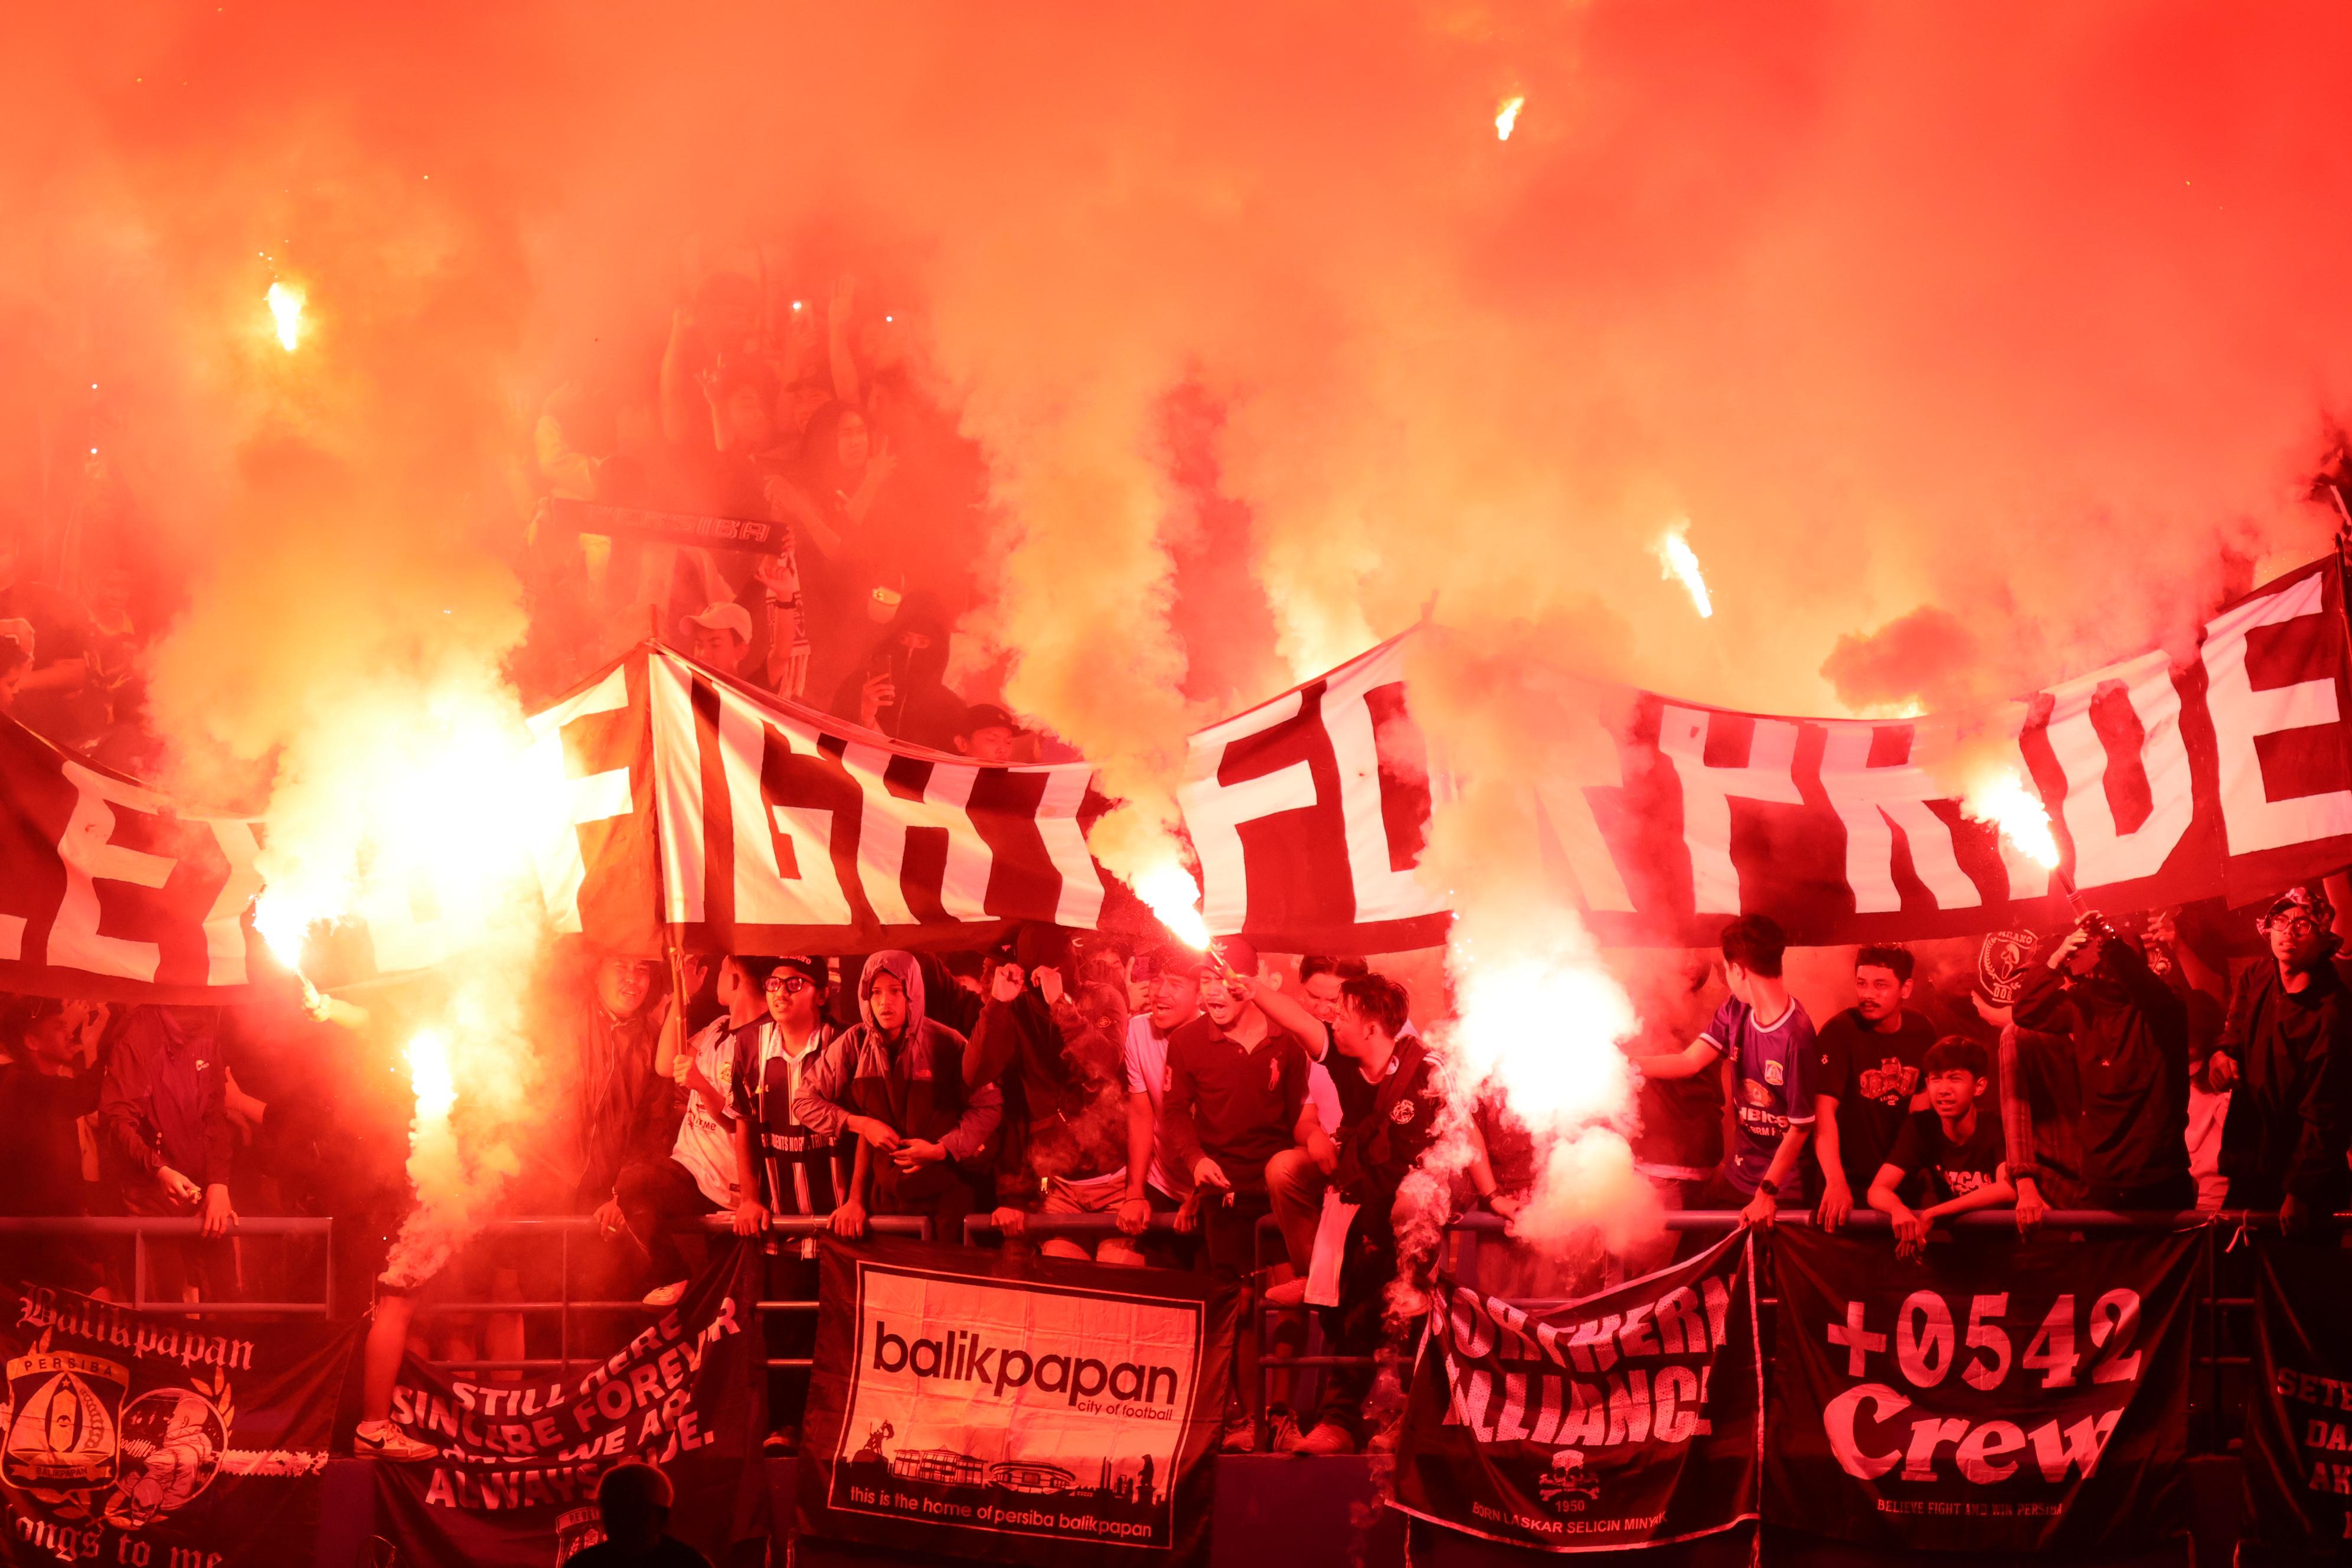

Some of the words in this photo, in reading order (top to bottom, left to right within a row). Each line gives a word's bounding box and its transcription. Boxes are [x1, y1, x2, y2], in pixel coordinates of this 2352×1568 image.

[524, 652, 1105, 933] FIGHT
[1659, 571, 2352, 915] PRIDE
[16, 1280, 254, 1371] Balikpapan
[1827, 1288, 2143, 1391] +0542
[24, 1358, 112, 1377] PERSIBA
[873, 1321, 1178, 1406] balikpapan
[452, 1381, 566, 1416] STILL
[1077, 1400, 1103, 1416] city
[1106, 1401, 1122, 1415] of
[1122, 1402, 1173, 1421] football
[1822, 1383, 2126, 1485] Crew
[36, 1466, 87, 1478] BALIKPAPAN
[425, 1463, 600, 1510] ALWAYS
[851, 1485, 875, 1504] this
[879, 1490, 890, 1506] is
[894, 1493, 917, 1510] the
[923, 1498, 971, 1517] home
[977, 1504, 994, 1520] of
[994, 1506, 1054, 1528] persiba
[1059, 1513, 1152, 1538] balikpapan
[1472, 1501, 1501, 1522] BORN
[1504, 1512, 1563, 1534] LASKAR
[1566, 1519, 1621, 1534] SELICIN
[1624, 1511, 1668, 1531] MINYAK
[1555, 1500, 1585, 1513] 1950
[1877, 1498, 1924, 1514] BELIEVE
[1928, 1501, 1962, 1515] FIGHT
[117, 1532, 151, 1567] to
[170, 1546, 223, 1568] me
